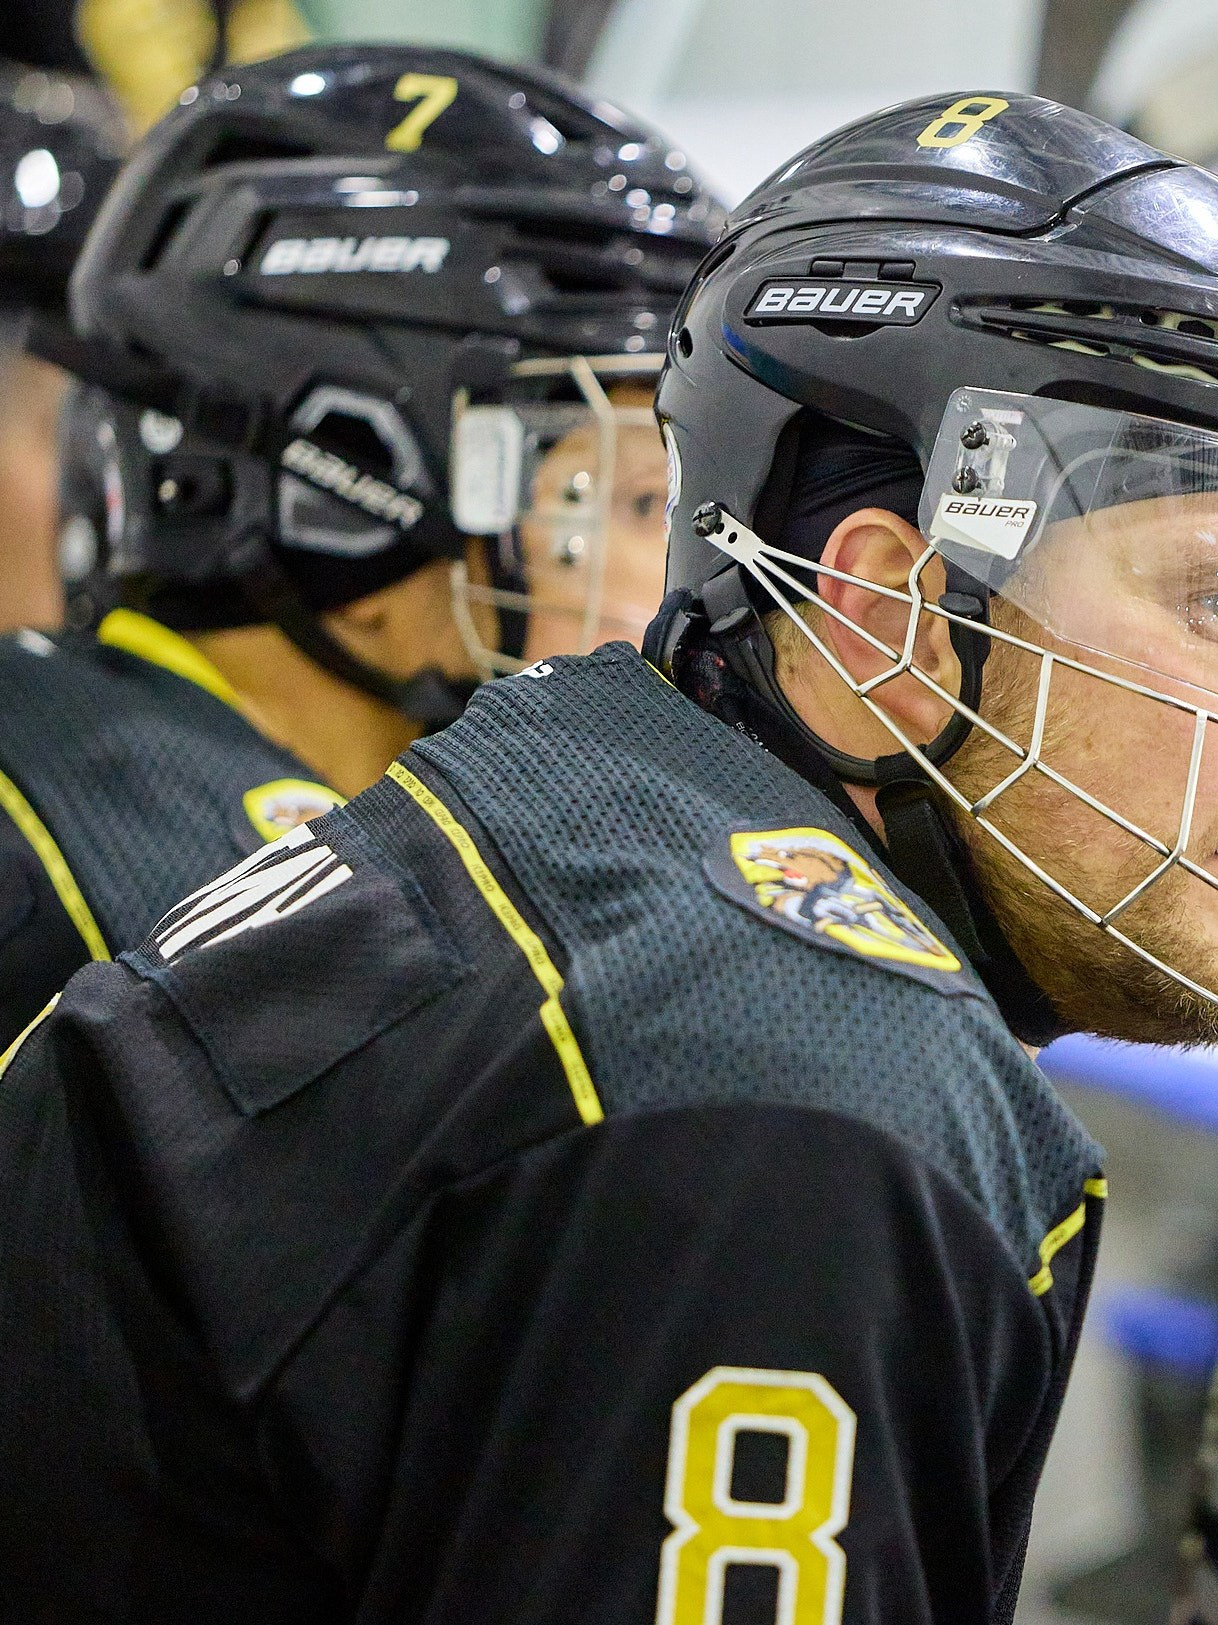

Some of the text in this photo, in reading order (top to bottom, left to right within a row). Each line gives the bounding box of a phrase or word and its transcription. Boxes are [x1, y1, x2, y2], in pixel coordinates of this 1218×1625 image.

[385, 72, 459, 153] 7
[916, 96, 1010, 148] 8
[755, 287, 925, 317] BAUER
[945, 501, 1030, 519] BAUER
[1004, 520, 1025, 528] PRO
[655, 1365, 858, 1625] 8
